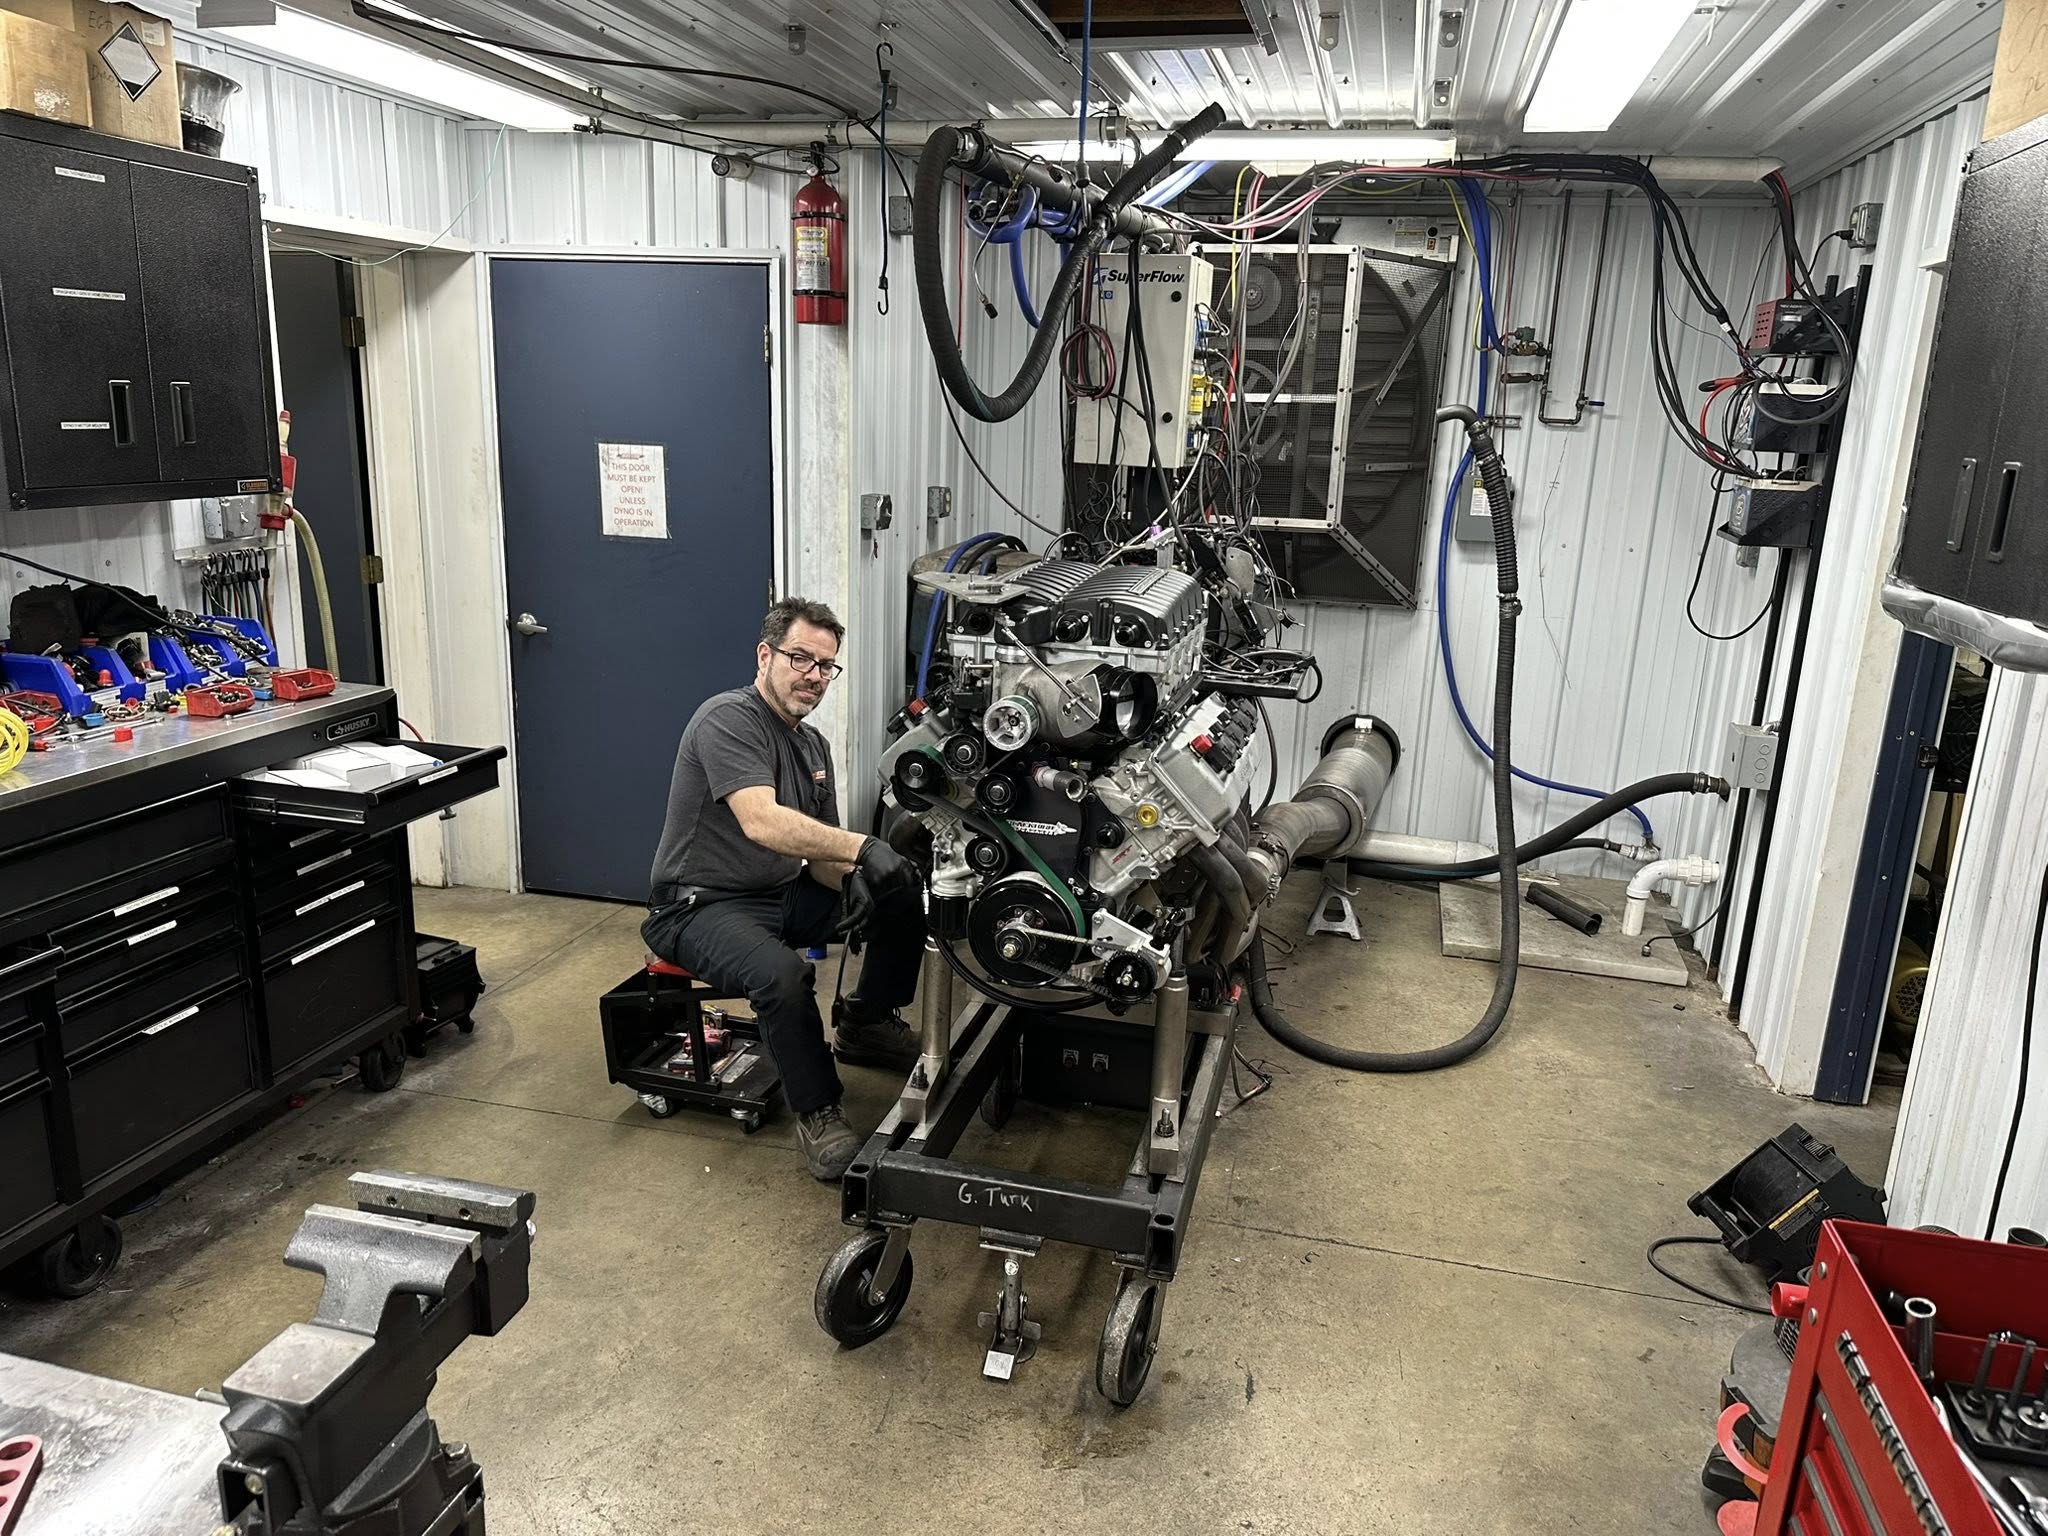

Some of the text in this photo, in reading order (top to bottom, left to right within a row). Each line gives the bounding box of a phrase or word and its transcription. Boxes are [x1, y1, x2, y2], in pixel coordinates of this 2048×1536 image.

[611, 463, 650, 472] THIS DOOR
[607, 473, 656, 483] MUST BE KEPT
[619, 497, 646, 505] UNLESS
[614, 507, 635, 515] DYNO
[614, 518, 654, 527] OPERATION
[344, 717, 370, 732] HUSKY
[958, 1182, 978, 1204] G.
